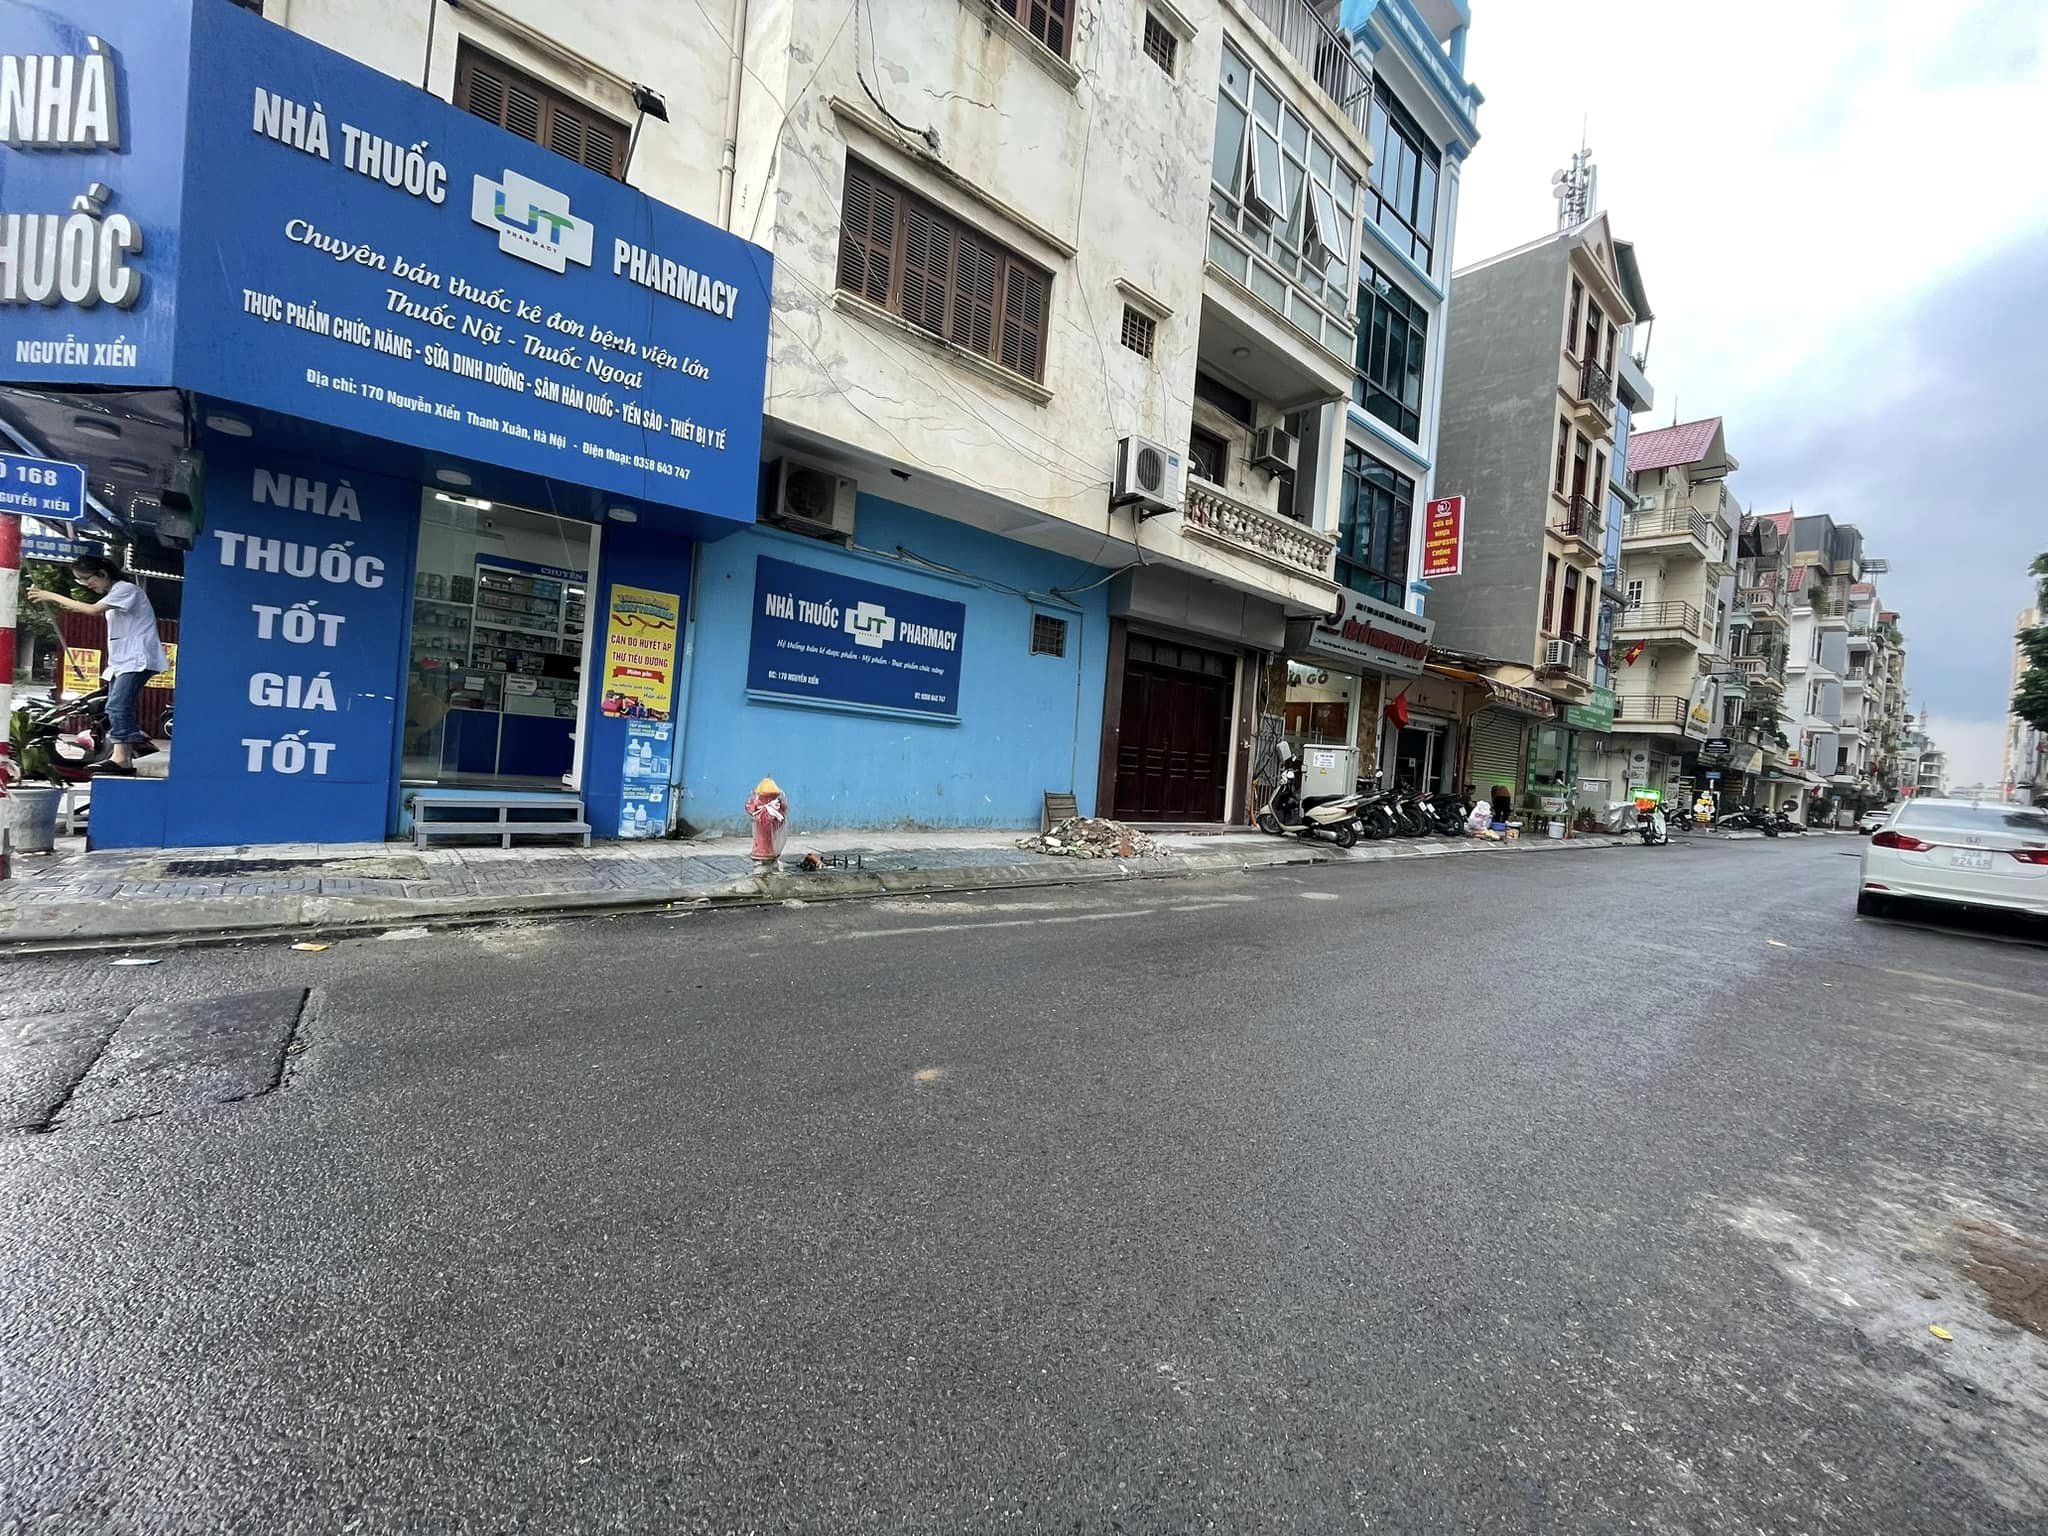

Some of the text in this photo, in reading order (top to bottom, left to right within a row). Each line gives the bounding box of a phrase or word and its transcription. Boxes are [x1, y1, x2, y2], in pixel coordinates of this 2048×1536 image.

[0, 35, 114, 146] NHÀ
[252, 86, 447, 204] NHÀ THUỐC
[0, 183, 135, 305] HUỐC
[506, 229, 558, 254] PHARMACY
[285, 219, 710, 381] Chuyên bán thuốc kê đơn bệnh viện lớn
[613, 238, 739, 320] PHARMACY
[16, 333, 137, 367] NGUYỄN XIỂN
[386, 289, 457, 330] Thuốc
[461, 314, 502, 346] Nội
[523, 334, 583, 369] Thuốc
[585, 356, 643, 391] Ngoại
[243, 289, 283, 323] THỰC
[286, 300, 330, 335] PHẨM
[333, 316, 371, 348] CHỨC
[373, 328, 413, 360] NĂNG
[424, 342, 450, 371] SỮA
[452, 350, 483, 381] DINH
[485, 362, 525, 393] DƯỠNG
[534, 376, 559, 403] SÂM
[561, 384, 584, 411] HÀN
[585, 392, 613, 419] QUỐC
[622, 402, 641, 427] YẾN
[642, 407, 662, 432] SÀO
[670, 417, 694, 441] THIẾT
[696, 426, 707, 448] BỊ
[707, 430, 715, 446] Y
[715, 427, 727, 451] TẾ
[306, 368, 329, 388] Địa
[360, 383, 384, 401] 170
[386, 390, 432, 416] Nguyễn
[466, 411, 500, 432] Thanh
[501, 418, 531, 441] Xuân,
[533, 428, 547, 445] Hà
[549, 432, 567, 450] Nội
[582, 441, 604, 459] Điện
[656, 462, 673, 476] 643
[674, 466, 691, 480] 747
[0, 491, 38, 507] GUYỄN
[16, 465, 58, 487] 168
[251, 468, 362, 522] NHÀ
[213, 529, 385, 589] THUỐC
[251, 600, 346, 647] TỐT
[765, 593, 839, 629] NHÀ THUỐC
[899, 621, 958, 652] PHARMACY
[249, 671, 337, 712] GIÁ
[241, 729, 337, 775] TỐT
